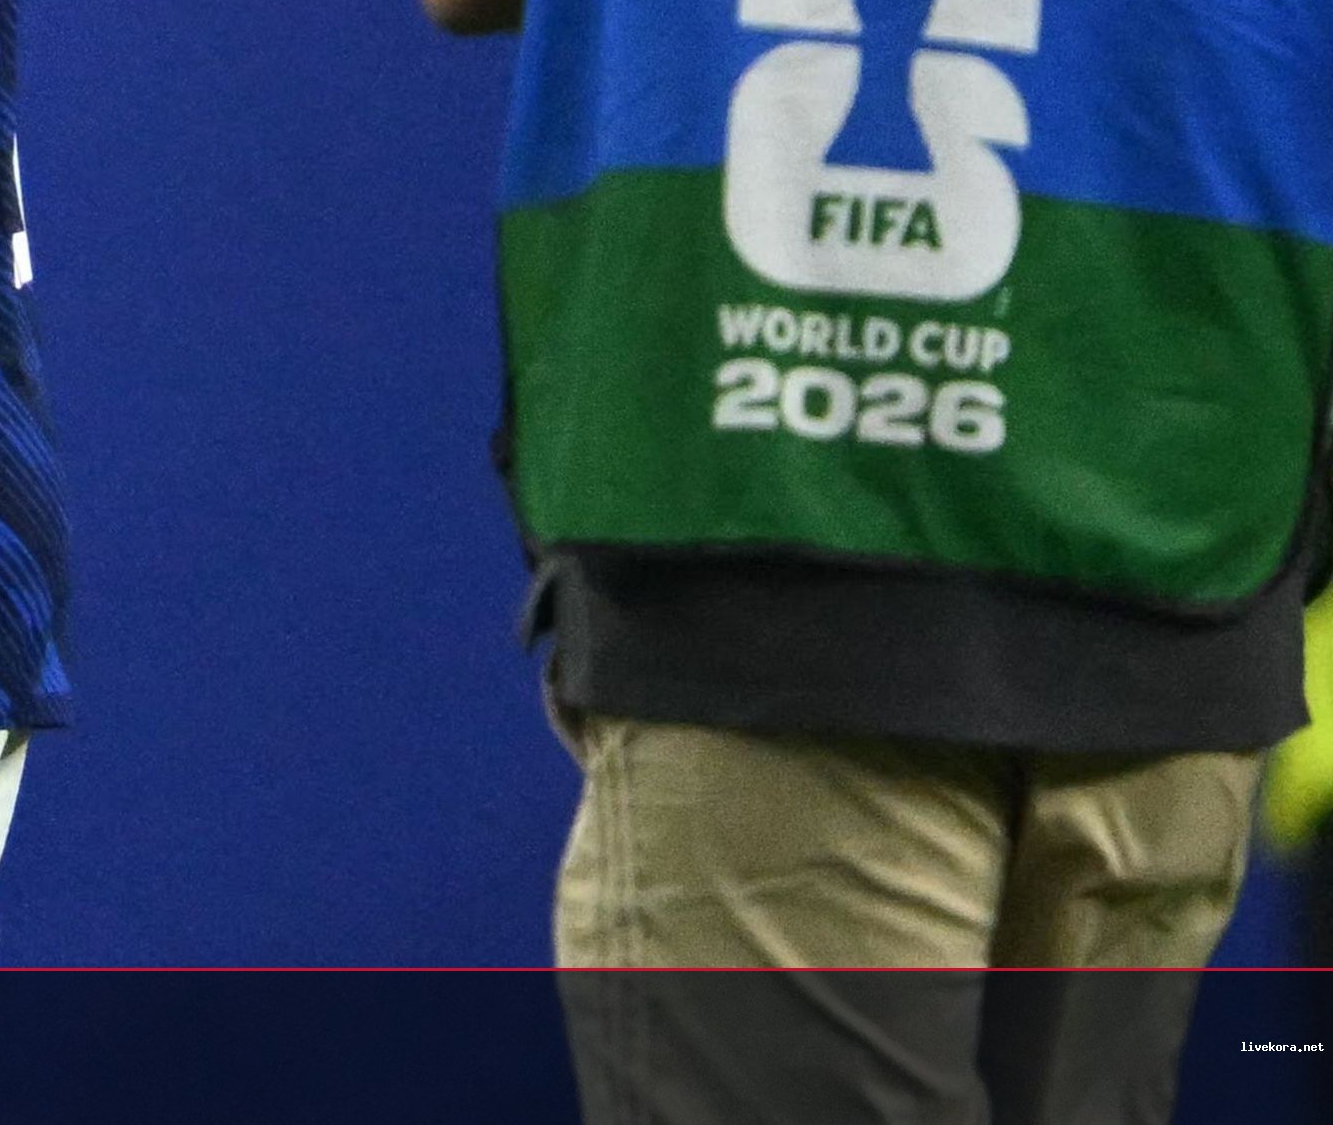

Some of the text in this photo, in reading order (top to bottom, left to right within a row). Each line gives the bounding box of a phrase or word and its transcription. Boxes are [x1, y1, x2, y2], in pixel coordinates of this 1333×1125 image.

[808, 191, 943, 251] FIFA
[717, 304, 1011, 374] WORLD CUP
[712, 357, 1007, 455] 2026
